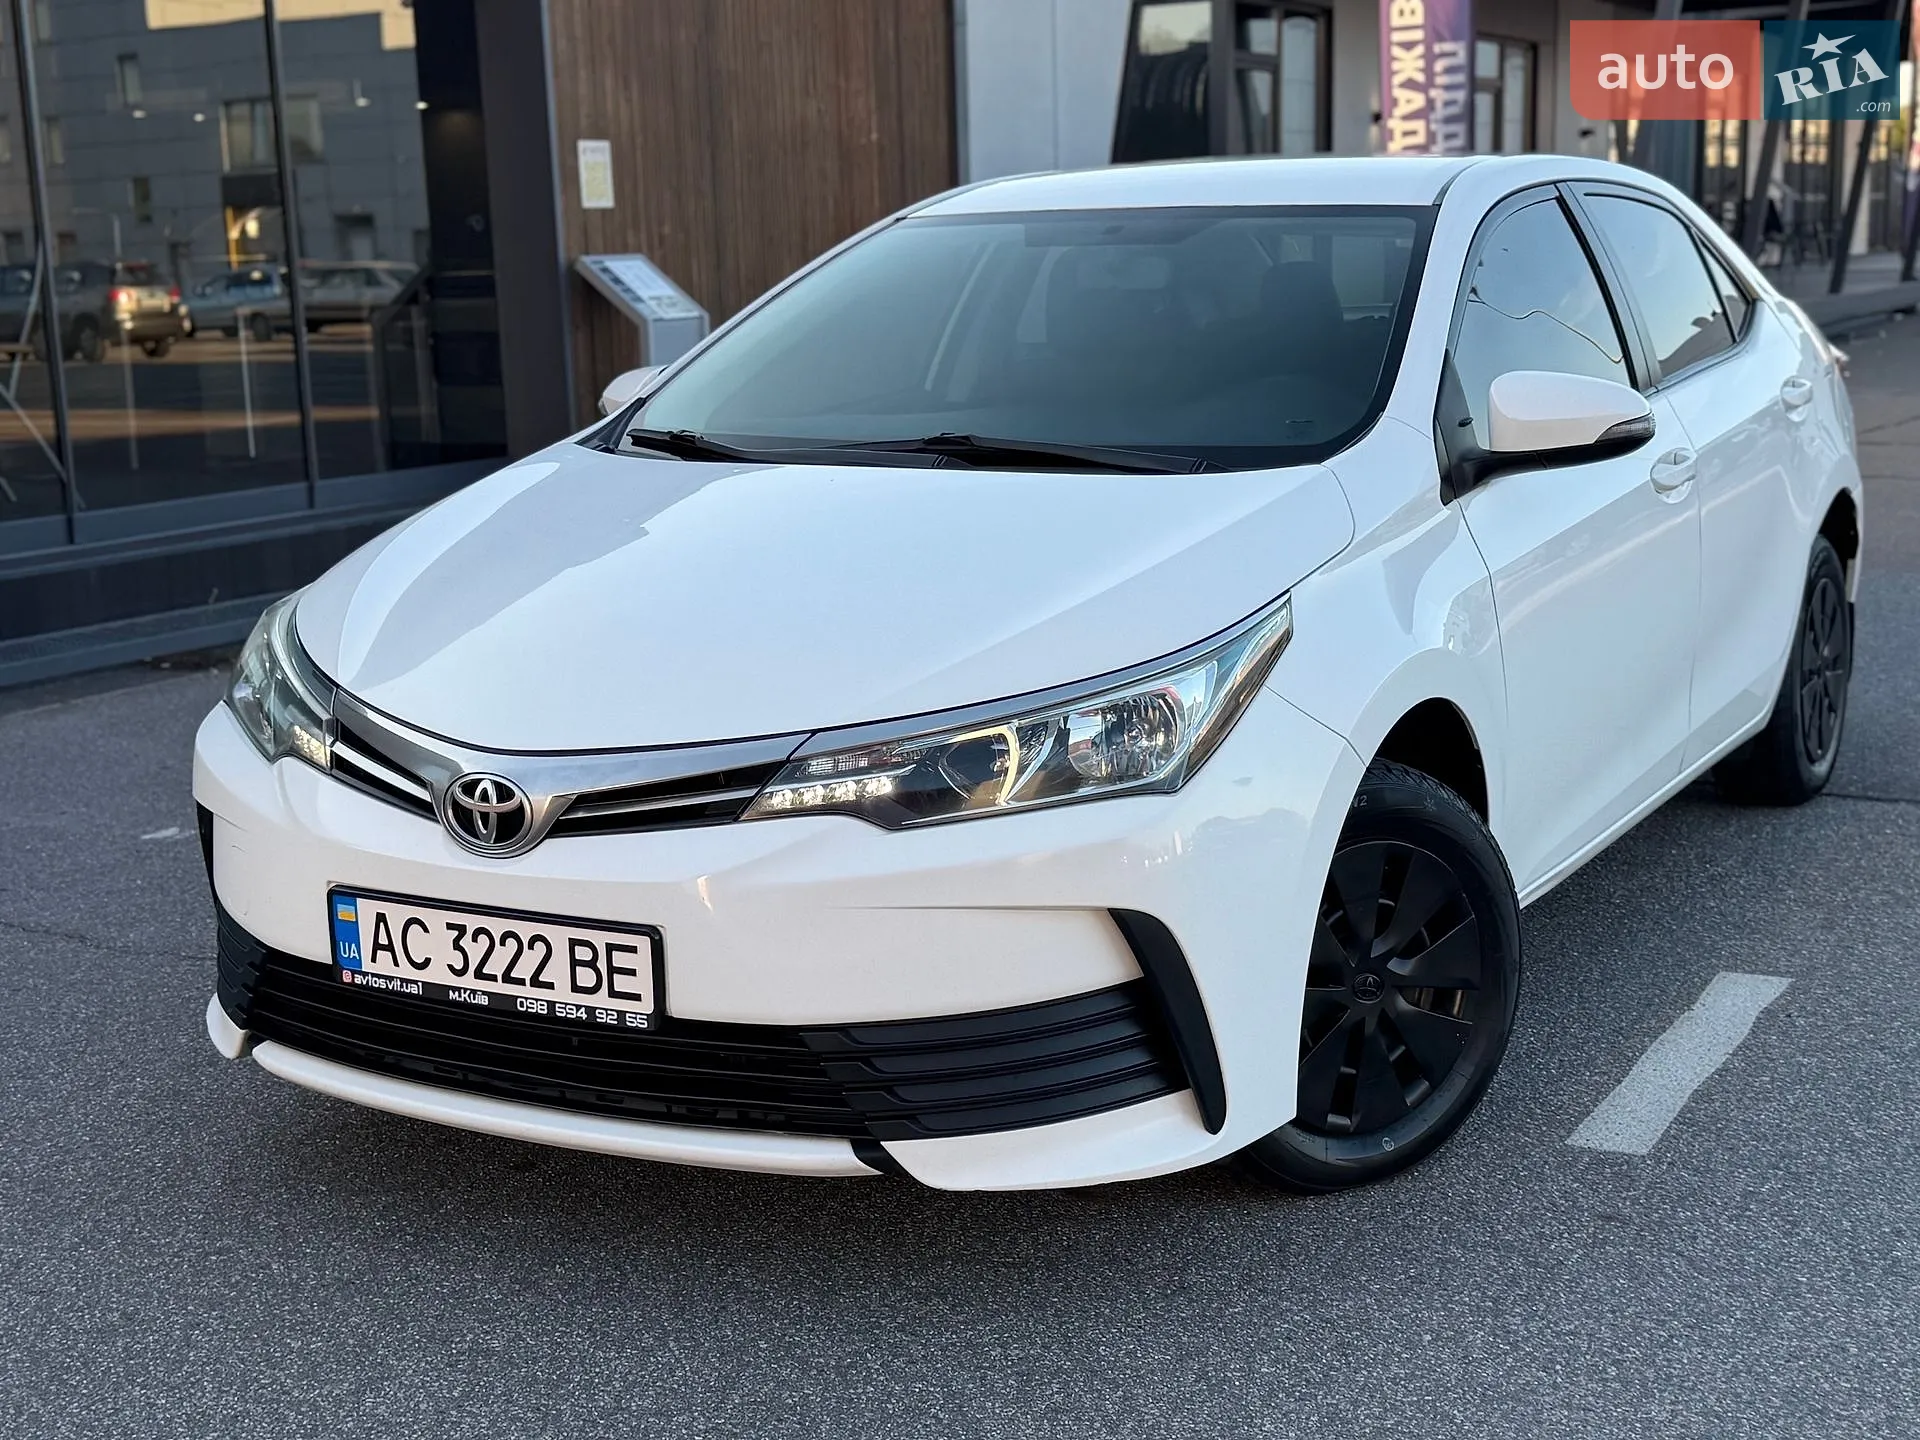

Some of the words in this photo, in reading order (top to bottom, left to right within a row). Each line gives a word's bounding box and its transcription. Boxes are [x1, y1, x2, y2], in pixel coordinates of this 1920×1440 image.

[340, 941, 360, 960] UA
[370, 911, 432, 971] AC
[445, 921, 555, 991] 3222
[568, 937, 642, 1003] BE
[516, 998, 548, 1014] 098
[555, 1003, 588, 1020] 594
[595, 1009, 618, 1025] 92
[625, 1013, 648, 1028] 55
